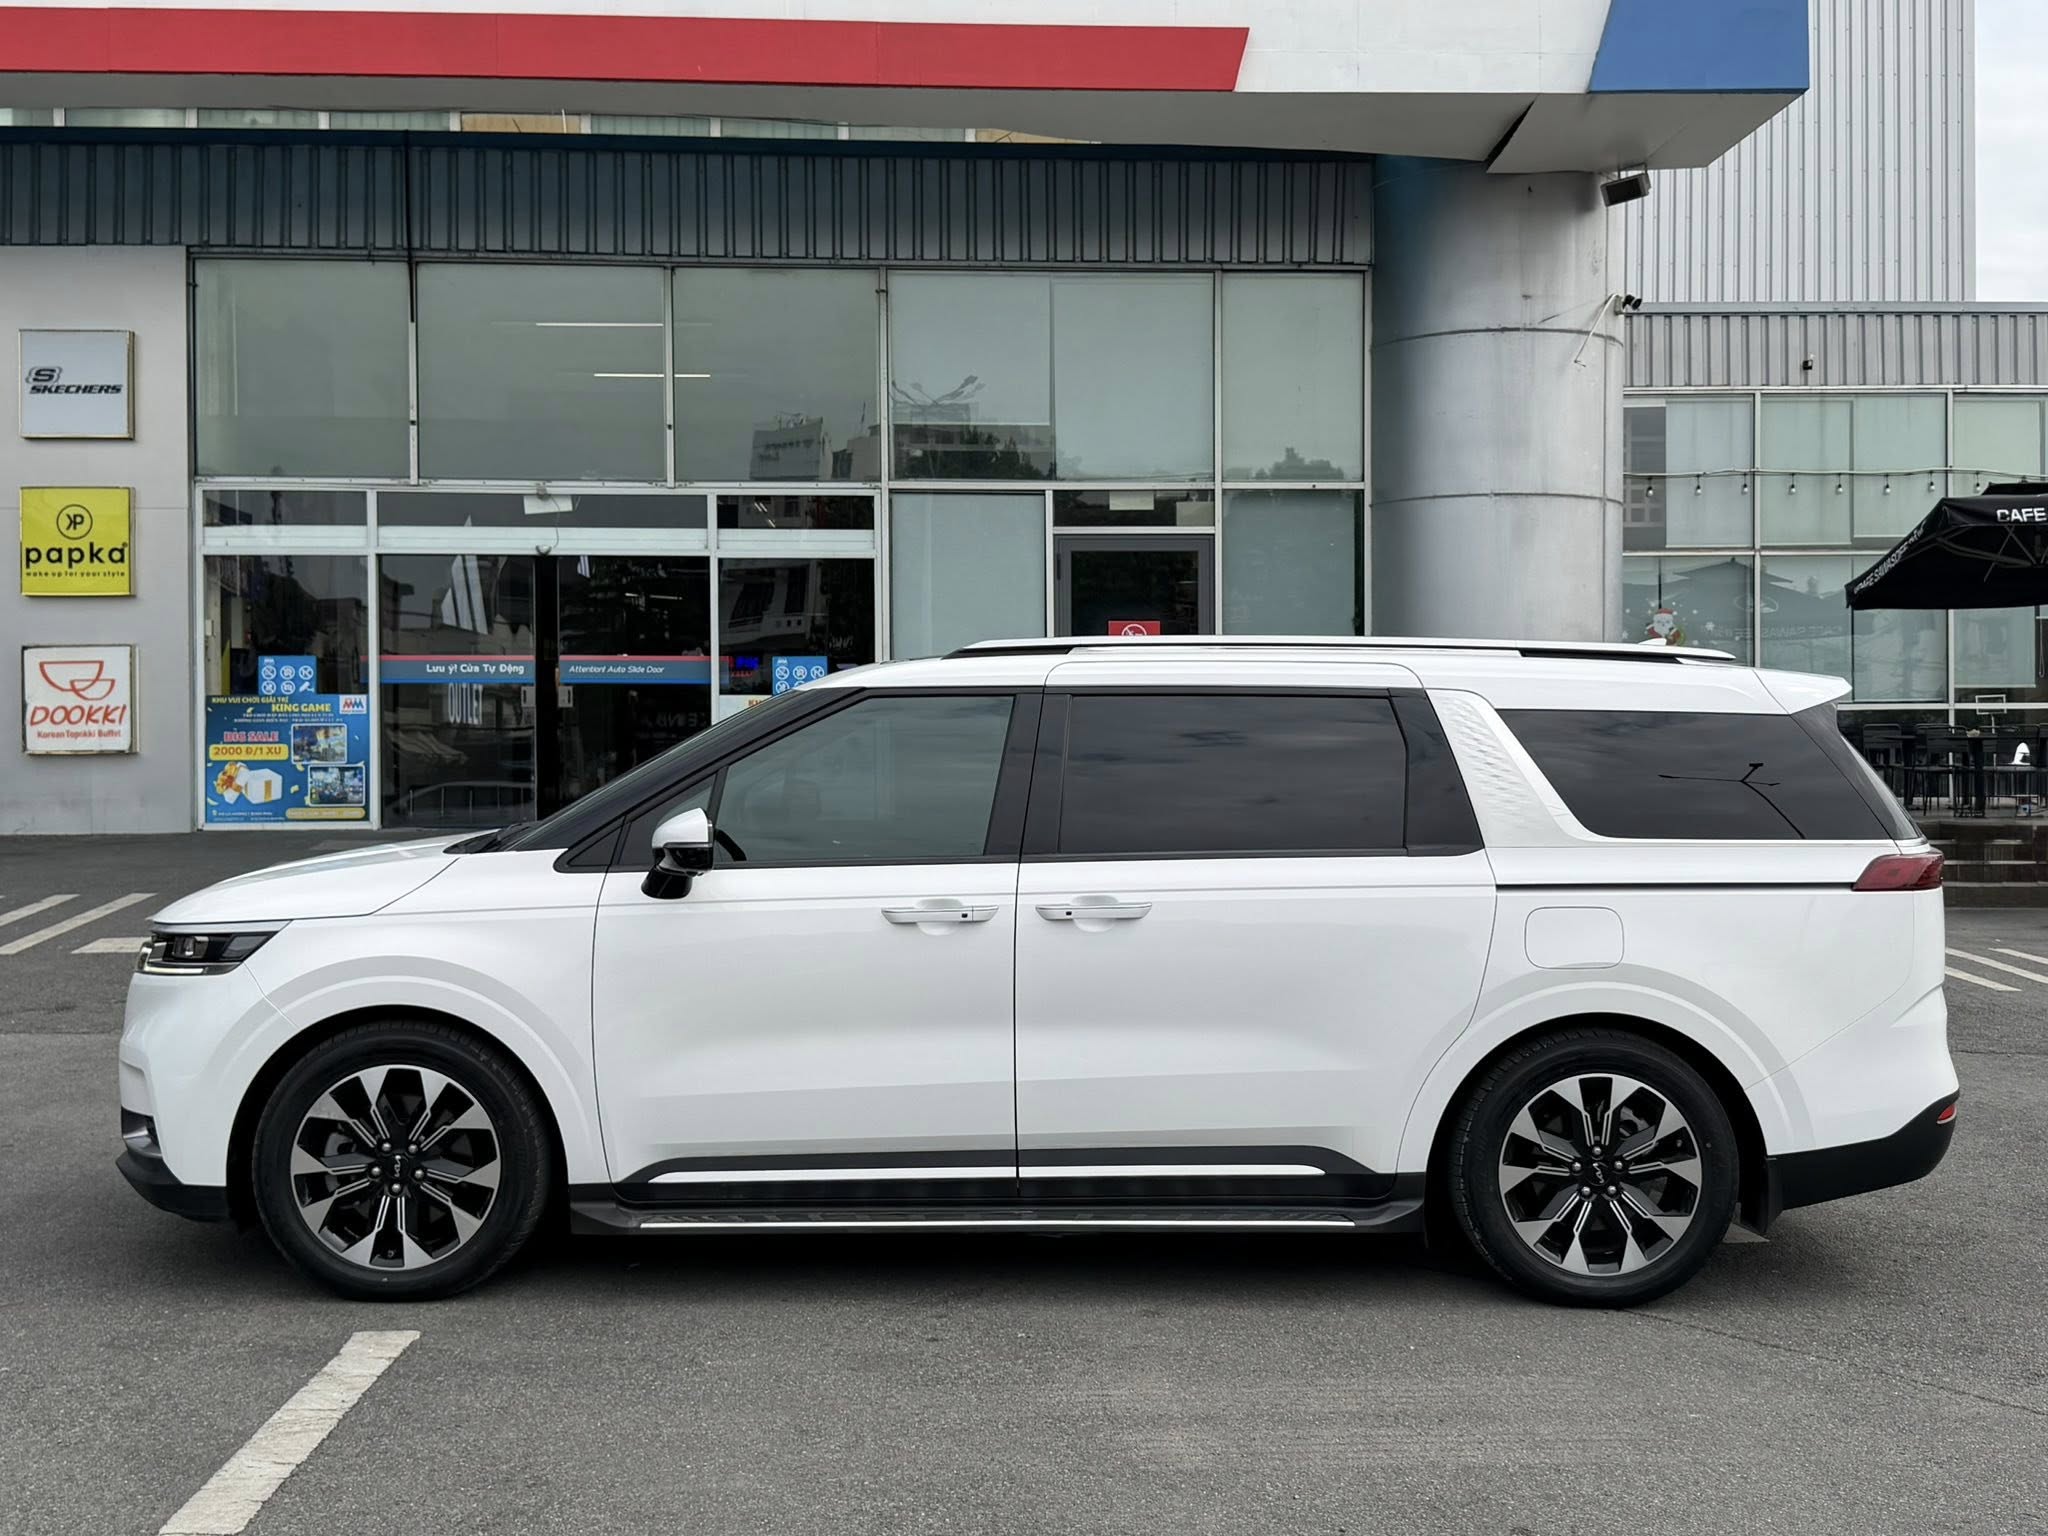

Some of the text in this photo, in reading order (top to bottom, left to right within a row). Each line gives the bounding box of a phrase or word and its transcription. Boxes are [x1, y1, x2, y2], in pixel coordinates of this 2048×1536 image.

[29, 384, 122, 394] SKECHERS
[1996, 508, 2047, 522] CAFE
[25, 541, 125, 569] papka
[426, 664, 446, 673] Lưu
[460, 663, 480, 673] Cửa
[482, 663, 496, 674] Tự
[499, 663, 525, 674] Động
[271, 703, 331, 713] KING GAME
[29, 704, 127, 726] DOOKKI
[224, 731, 279, 742] BIG SALE
[213, 746, 243, 756] 2000
[266, 746, 282, 755] XU
